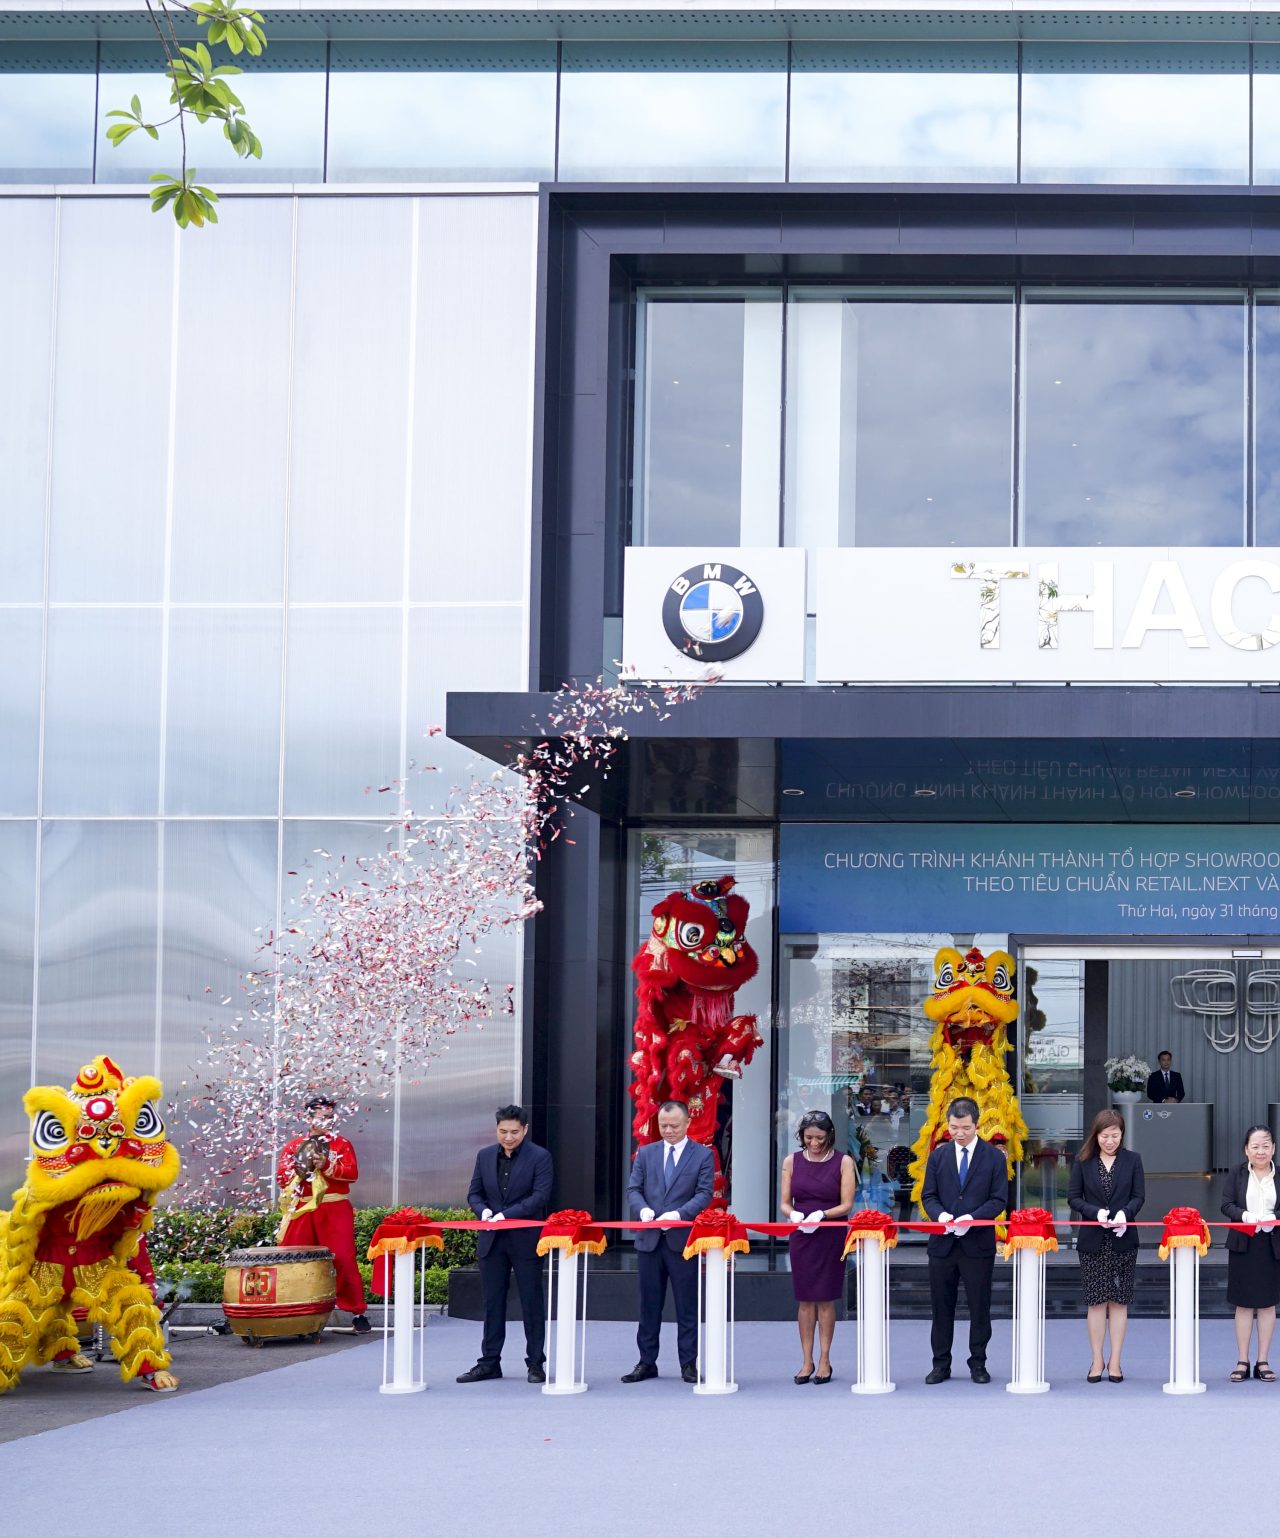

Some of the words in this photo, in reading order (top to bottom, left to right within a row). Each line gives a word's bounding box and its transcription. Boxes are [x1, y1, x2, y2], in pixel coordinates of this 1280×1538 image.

[671, 564, 756, 597] BMW
[824, 852, 904, 869] CHƯƠNG
[908, 849, 965, 868] TRÌNH
[971, 849, 1034, 868] KHÁNH
[1039, 849, 1104, 868] THÀNH
[1108, 846, 1134, 868] TỔ
[1140, 852, 1179, 871] HỢP
[962, 876, 1014, 892] THEO
[1018, 873, 1060, 892] TIÊU
[1066, 871, 1130, 891] CHUẨN
[1136, 876, 1251, 891] RETAIL.NEXT
[1256, 873, 1280, 891] VÀ
[1118, 903, 1146, 917] Thứ
[1150, 904, 1178, 919] Hai,
[1182, 904, 1216, 920] ngày
[1219, 904, 1233, 917] 31
[1238, 904, 1278, 919] tháng
